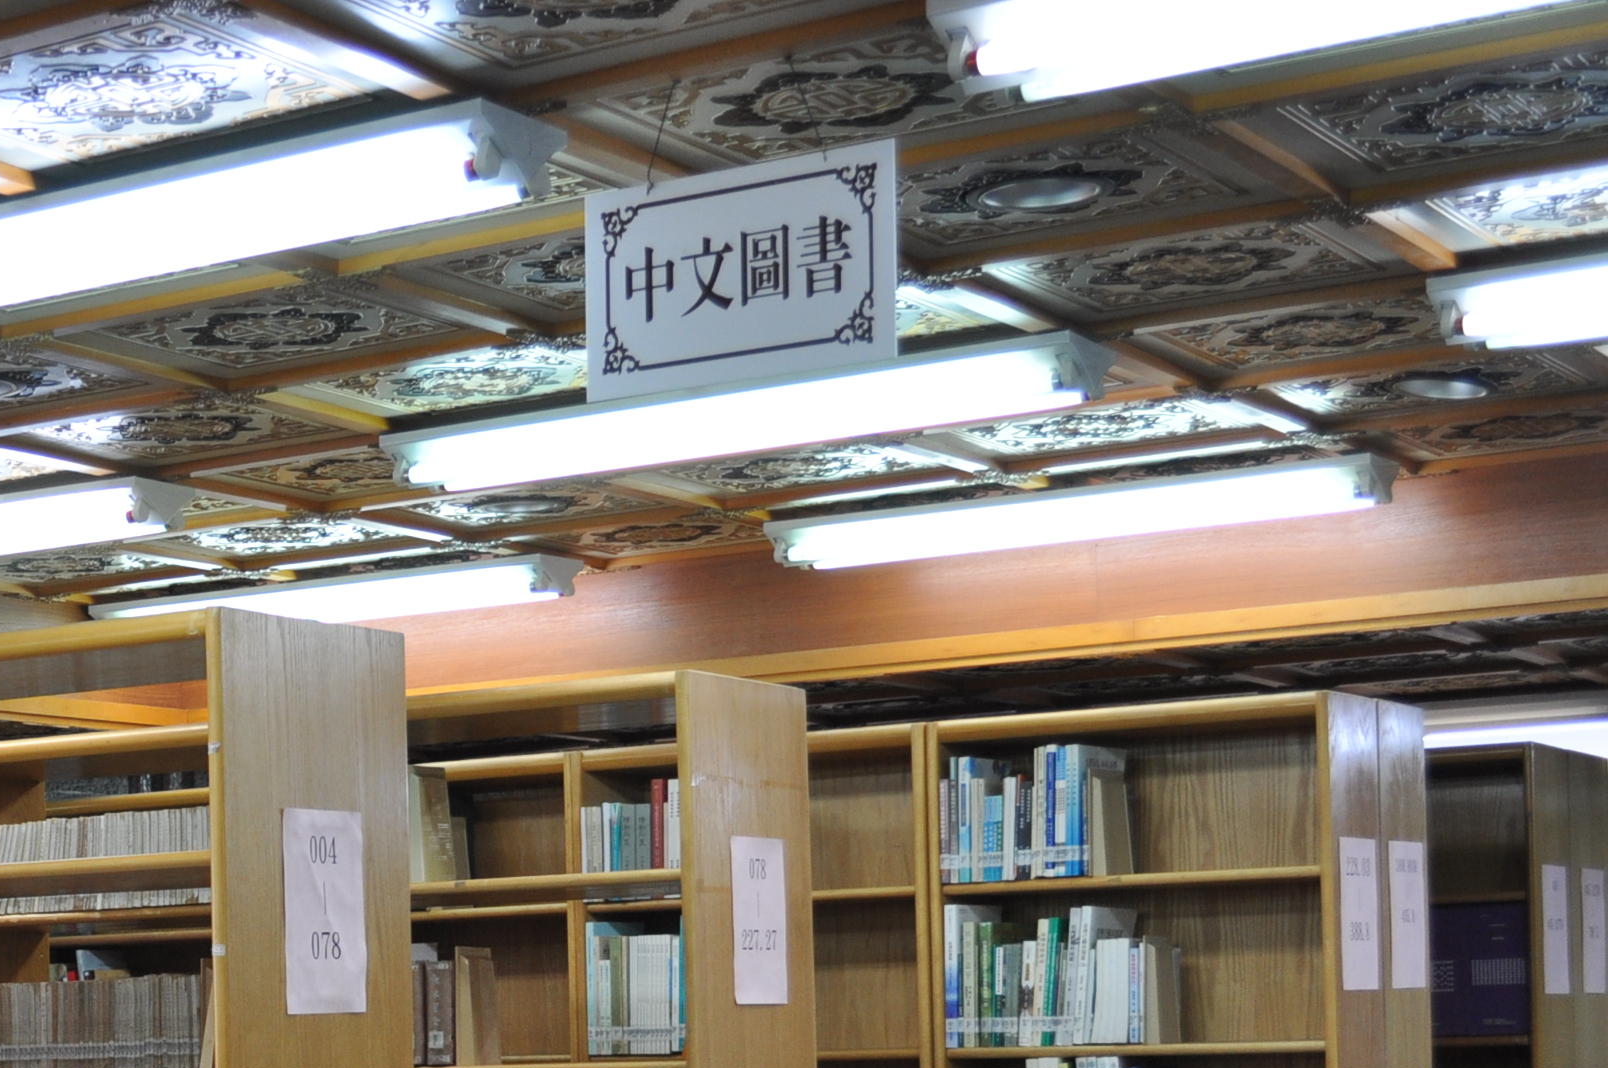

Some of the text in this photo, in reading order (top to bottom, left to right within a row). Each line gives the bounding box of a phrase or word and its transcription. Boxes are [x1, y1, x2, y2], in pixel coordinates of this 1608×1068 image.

[624, 215, 853, 323] 中文圖書
[309, 835, 338, 865] 004
[748, 857, 767, 880] 078
[311, 931, 342, 960] 078
[741, 928, 777, 951] 227.27
